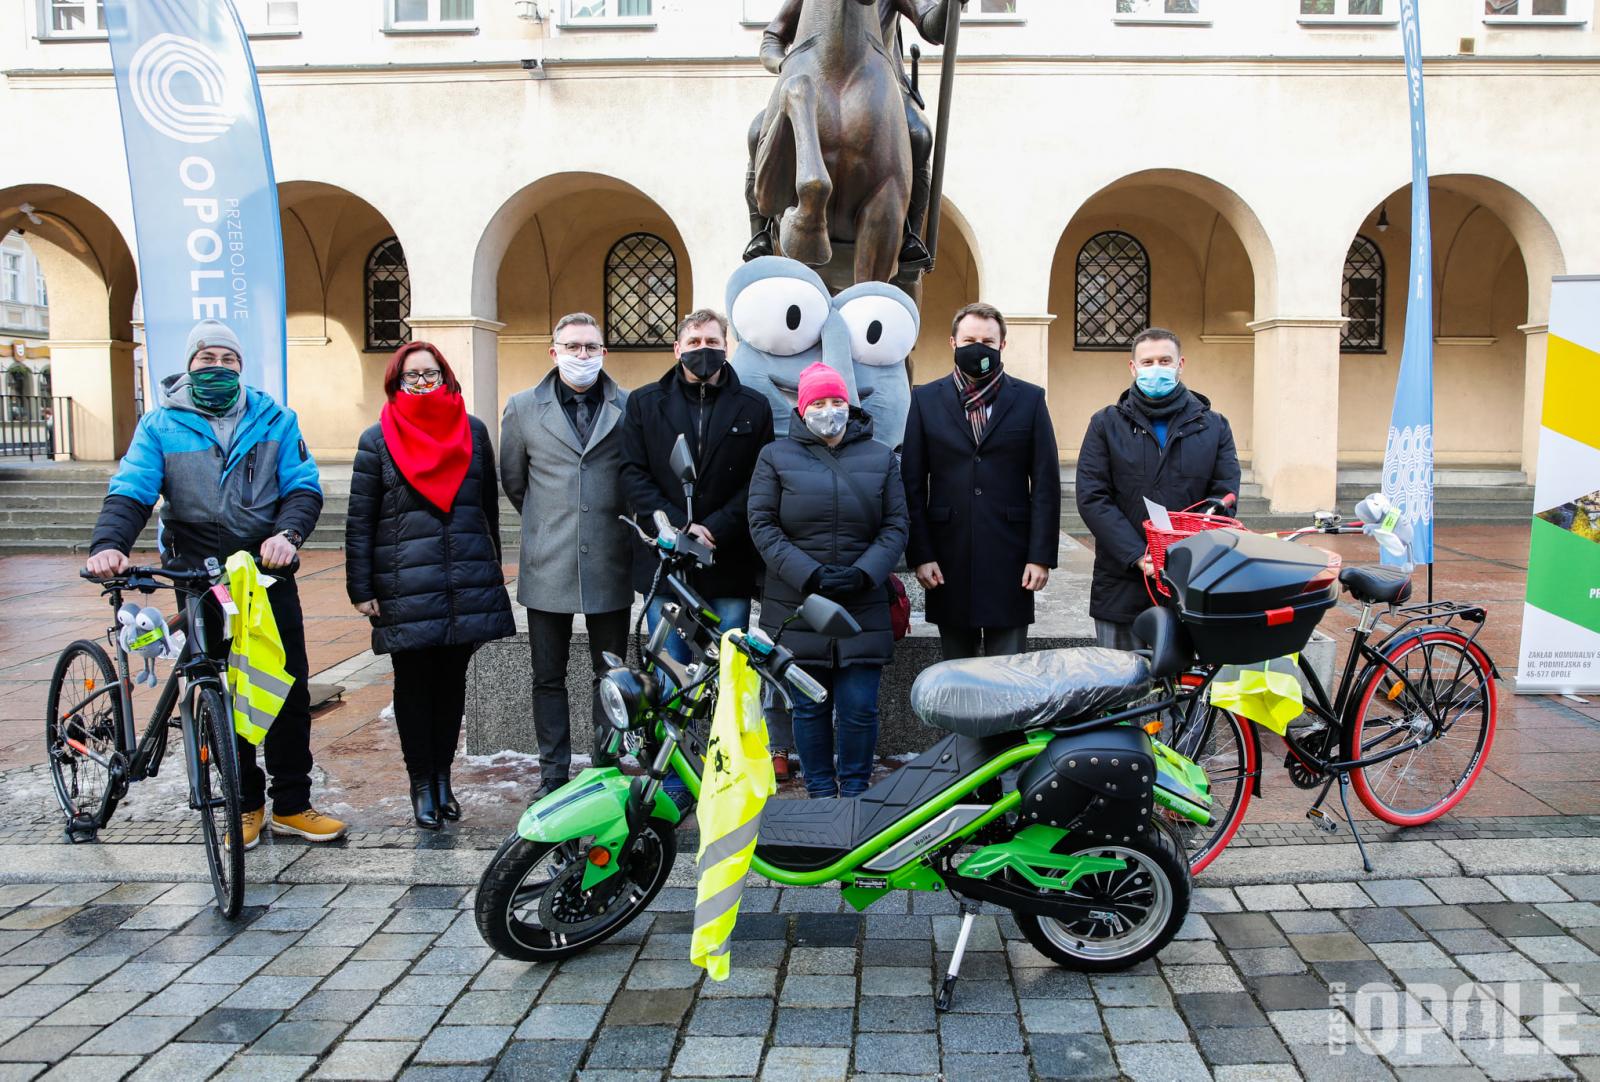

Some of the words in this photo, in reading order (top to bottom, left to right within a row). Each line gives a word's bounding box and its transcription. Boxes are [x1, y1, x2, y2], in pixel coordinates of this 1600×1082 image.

[179, 156, 227, 320] OPOLE
[224, 198, 248, 319] PRZEBOJOWE
[1551, 670, 1571, 678] OPOLE
[1554, 651, 1596, 659] KOMUNALNY
